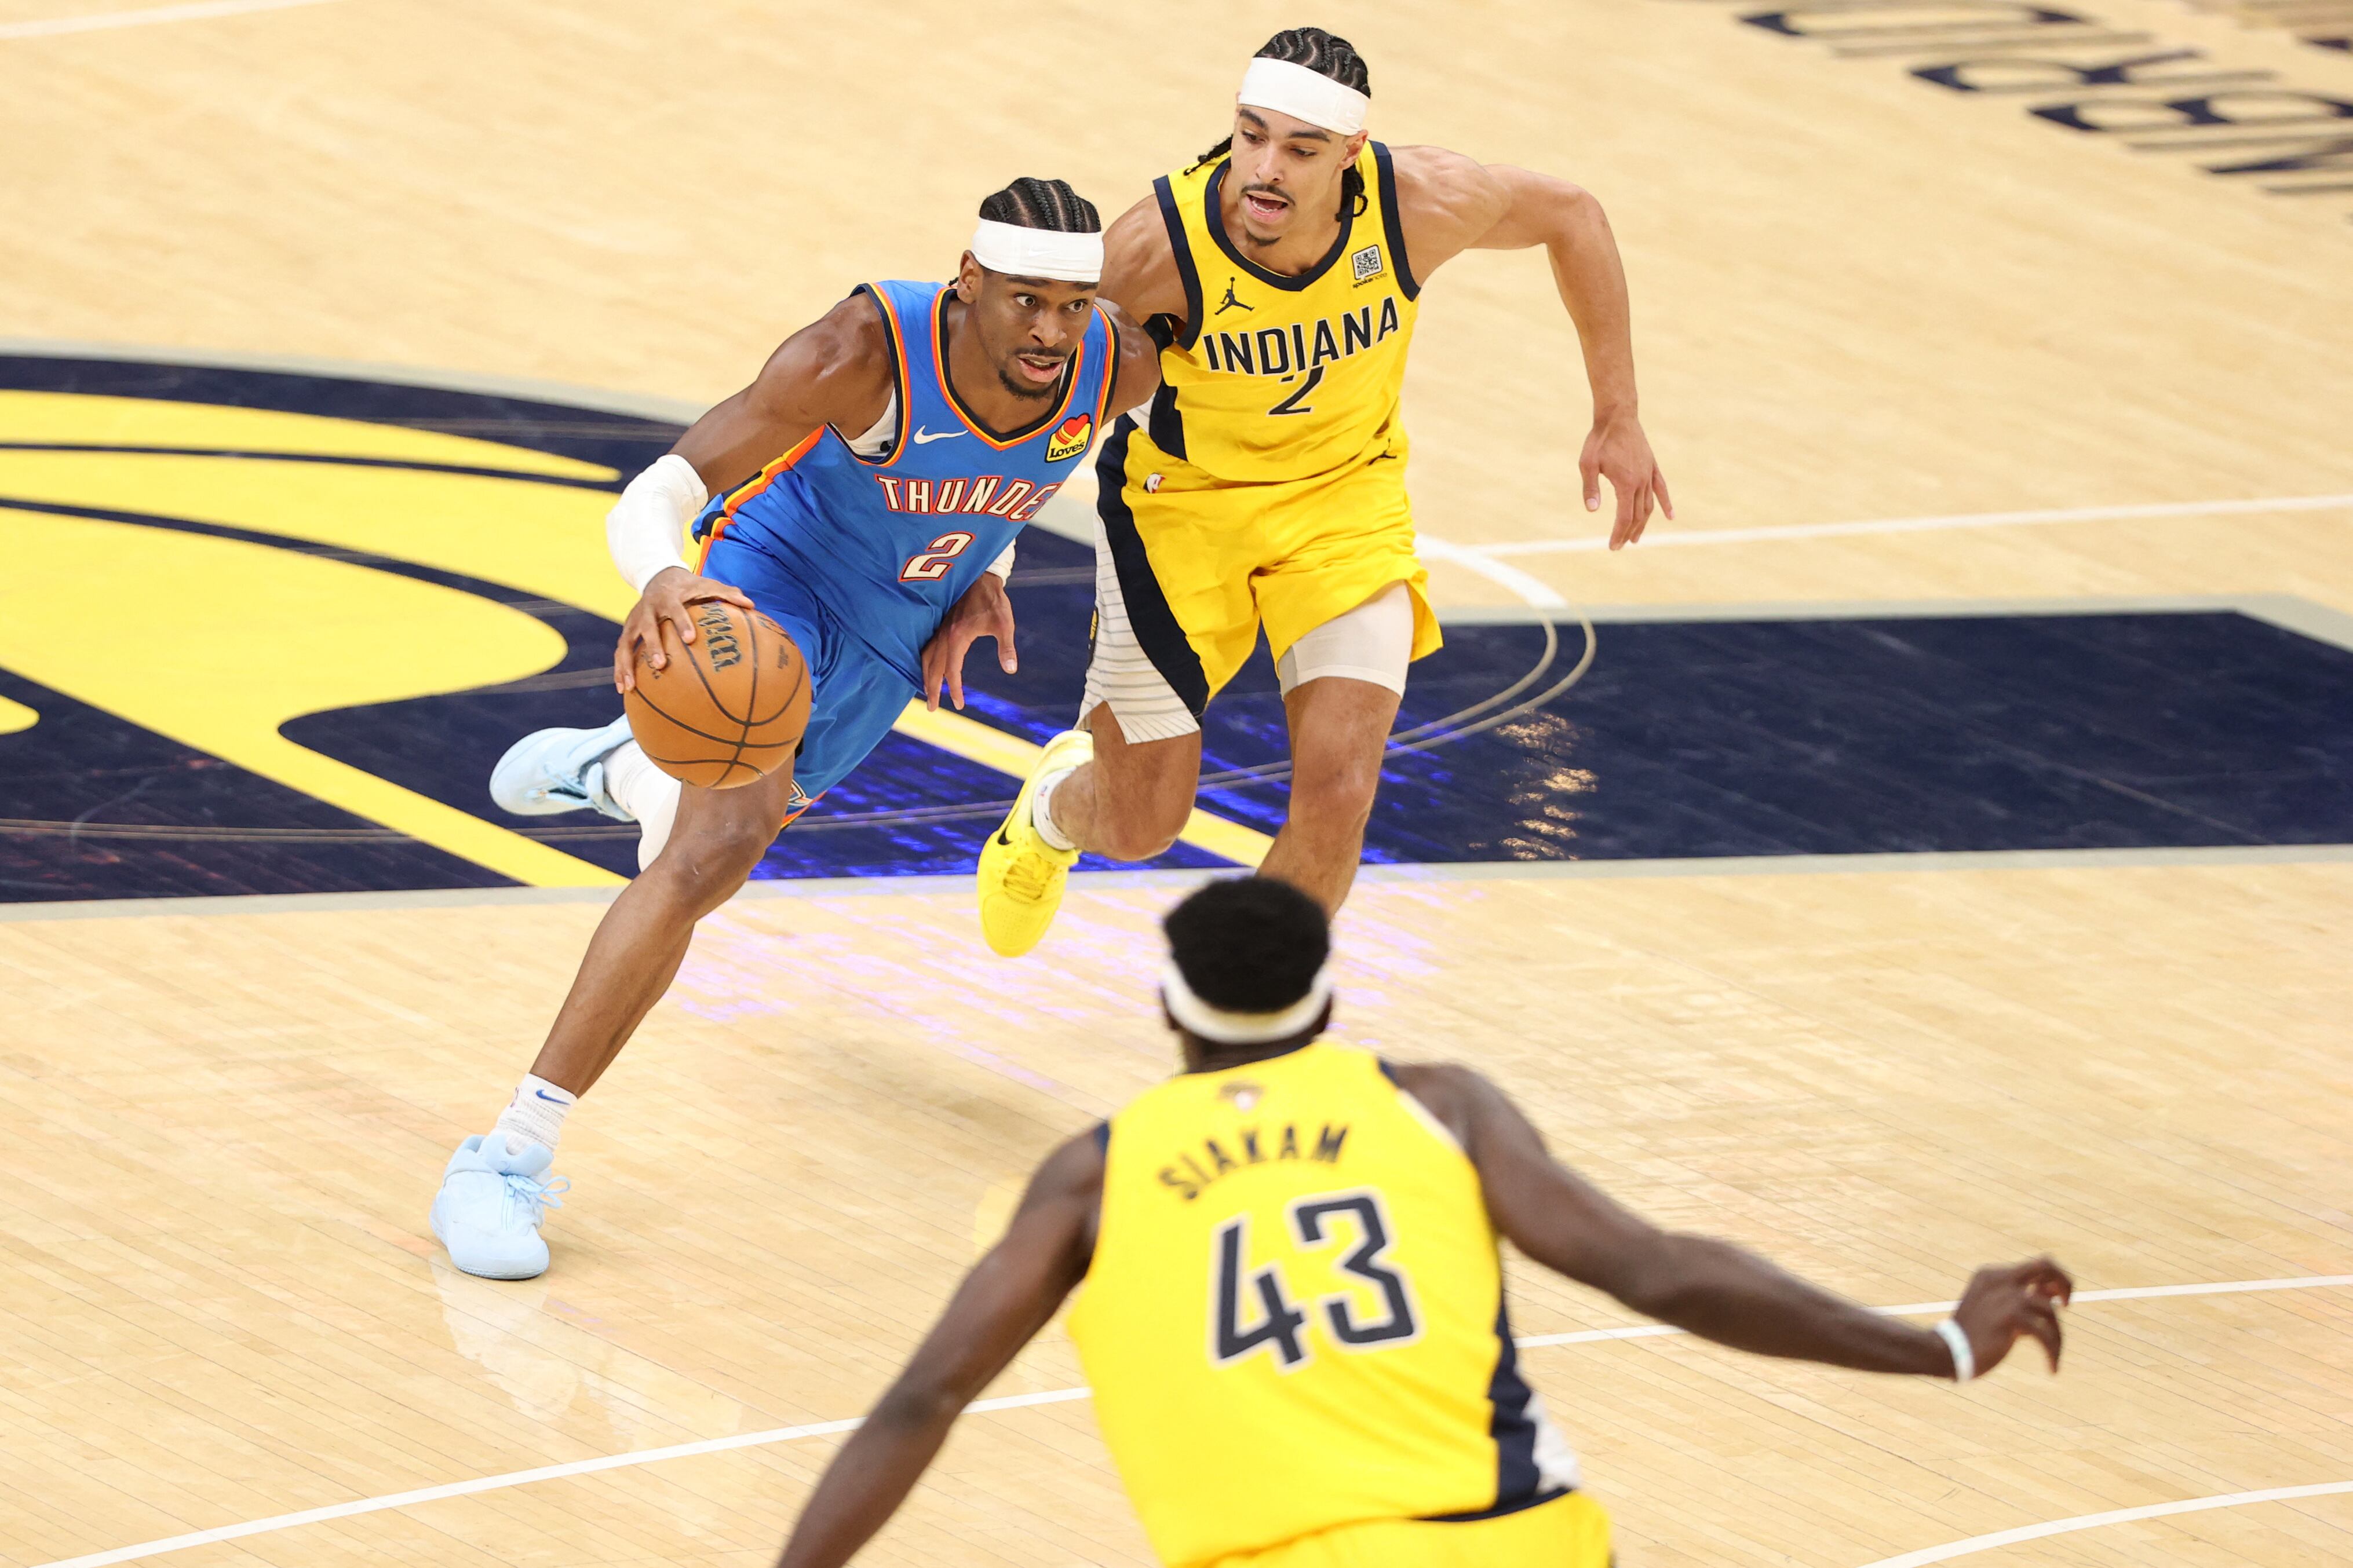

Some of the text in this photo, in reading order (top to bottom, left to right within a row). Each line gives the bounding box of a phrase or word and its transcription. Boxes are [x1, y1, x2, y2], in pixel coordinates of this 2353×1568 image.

[1202, 296, 1399, 375] INDIANA
[1265, 365, 1326, 416] 2
[1049, 440, 1085, 458] Love's
[874, 473, 1064, 521] THUNDE
[898, 531, 976, 582] 2
[1158, 1124, 1349, 1200] SIAKAM
[1211, 1187, 1424, 1374] 43
